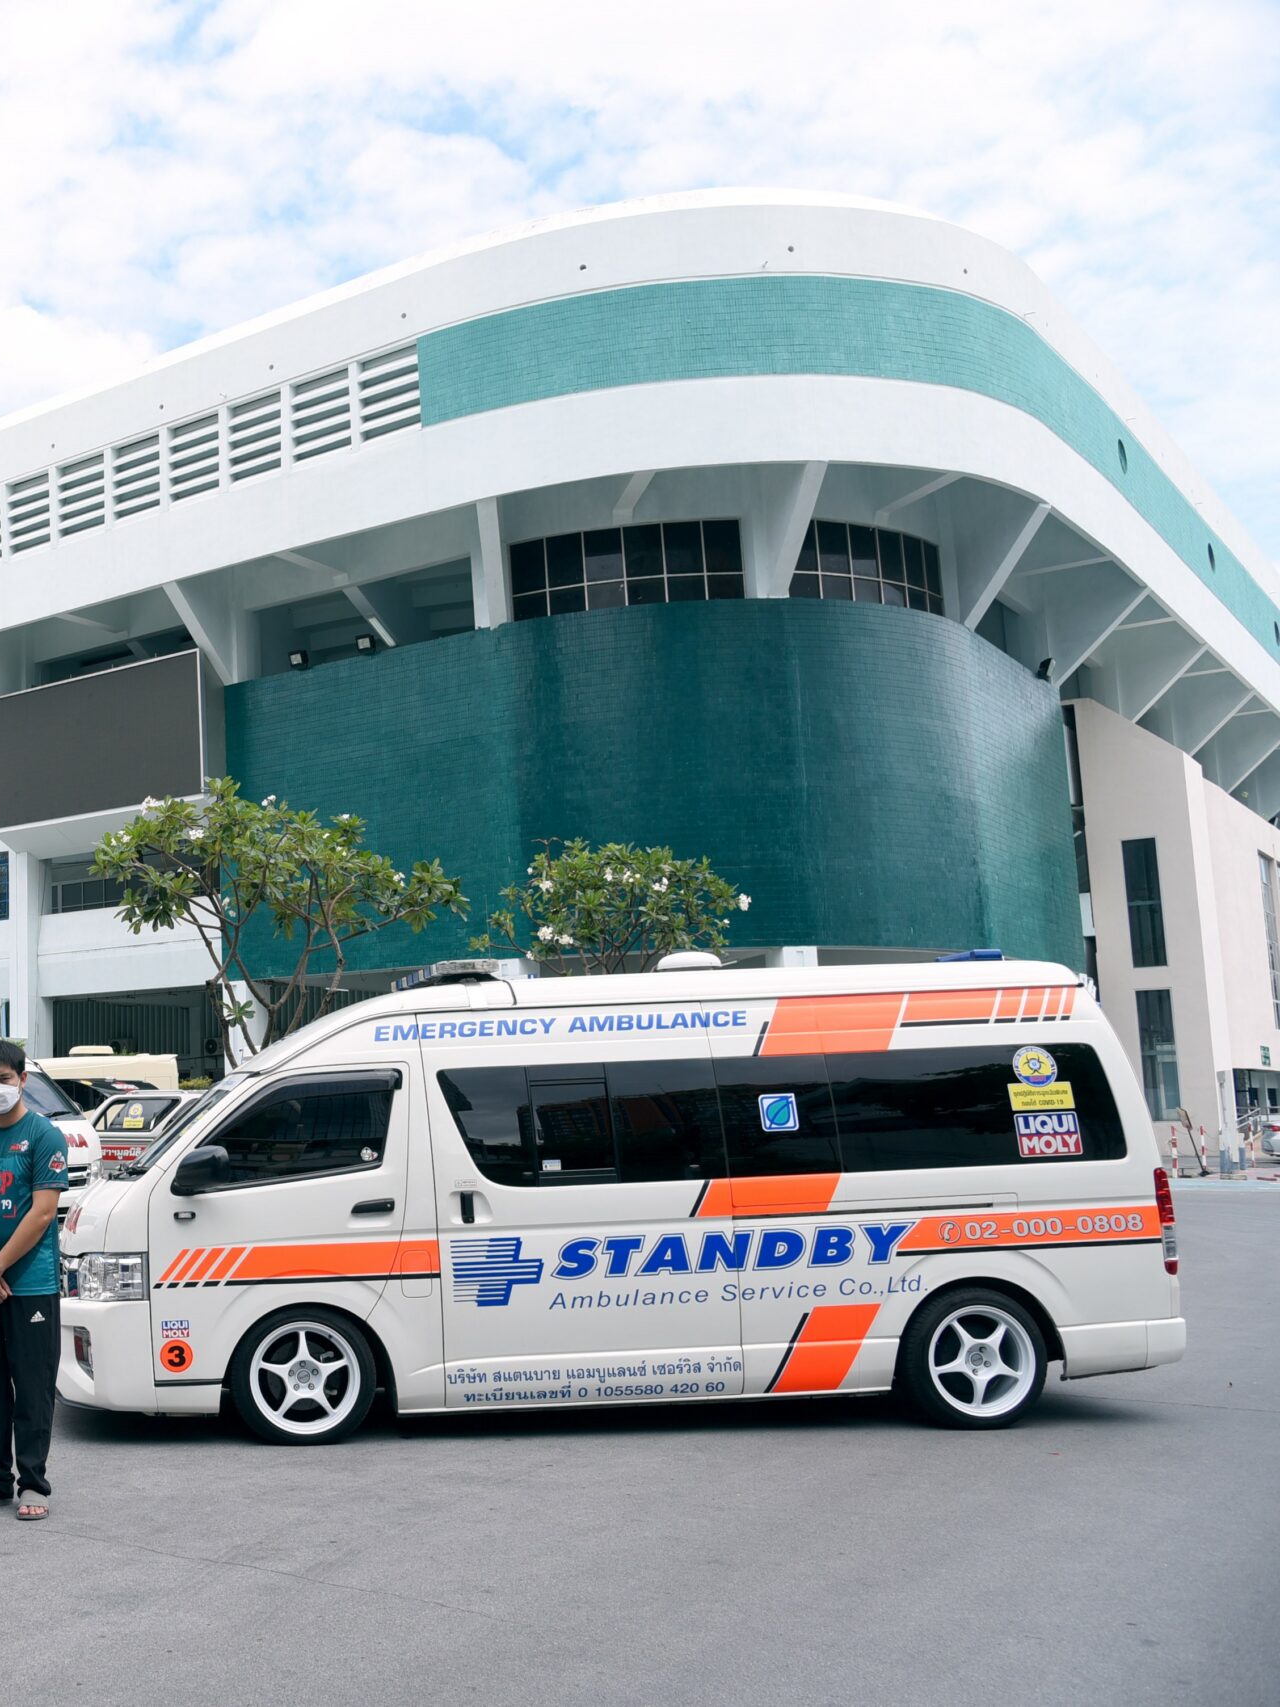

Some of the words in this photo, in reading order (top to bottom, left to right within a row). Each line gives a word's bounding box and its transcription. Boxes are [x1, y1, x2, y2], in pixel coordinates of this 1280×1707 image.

[374, 1018, 557, 1042] EMERGENCY
[568, 1010, 747, 1034] AMBULANCE
[1017, 1114, 1076, 1135] LIQUI
[1021, 1134, 1078, 1155] MOLY
[1, 1199, 12, 1210] 19
[551, 1222, 916, 1281] STANDBY
[964, 1213, 1144, 1240] 02-000-0808
[549, 1287, 709, 1310] Ambulance
[721, 1281, 827, 1302] Service
[162, 1321, 188, 1330] LIQUI
[163, 1330, 188, 1338] MOLY
[167, 1345, 186, 1367] 3
[447, 1368, 487, 1384] บริษัท
[493, 1369, 560, 1382] สแตนบาย
[566, 1360, 647, 1383] แอมบูแลนซ์
[652, 1358, 702, 1375] เซอร์วิส
[707, 1356, 742, 1372] จำกัด
[464, 1381, 571, 1402] ทะเบียนเลขที่
[578, 1387, 588, 1398] 0
[595, 1384, 664, 1397] 1055580
[670, 1382, 699, 1394] 420
[705, 1381, 725, 1392] 60
